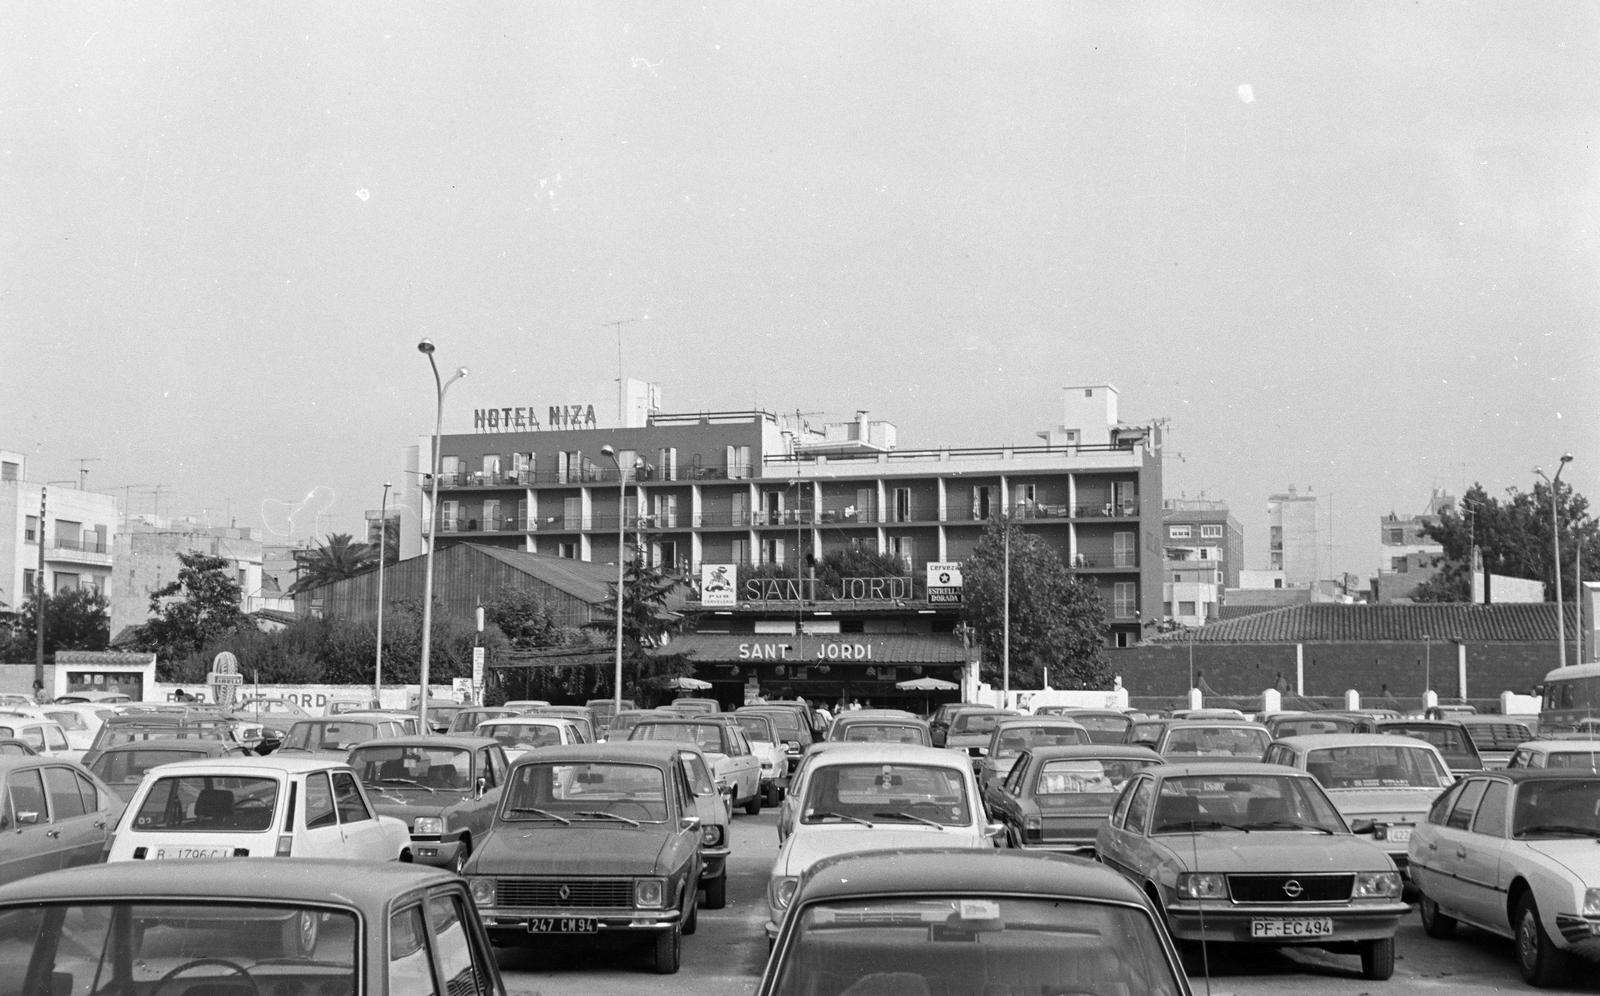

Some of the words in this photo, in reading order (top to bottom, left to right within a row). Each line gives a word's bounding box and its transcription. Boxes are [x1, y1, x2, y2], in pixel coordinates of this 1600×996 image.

[474, 406, 539, 428] HOTEL
[548, 404, 596, 427] NIZA
[830, 577, 912, 601] JORDI
[738, 643, 788, 660] SANT
[815, 643, 870, 660] JORDI
[532, 919, 554, 932] 247
